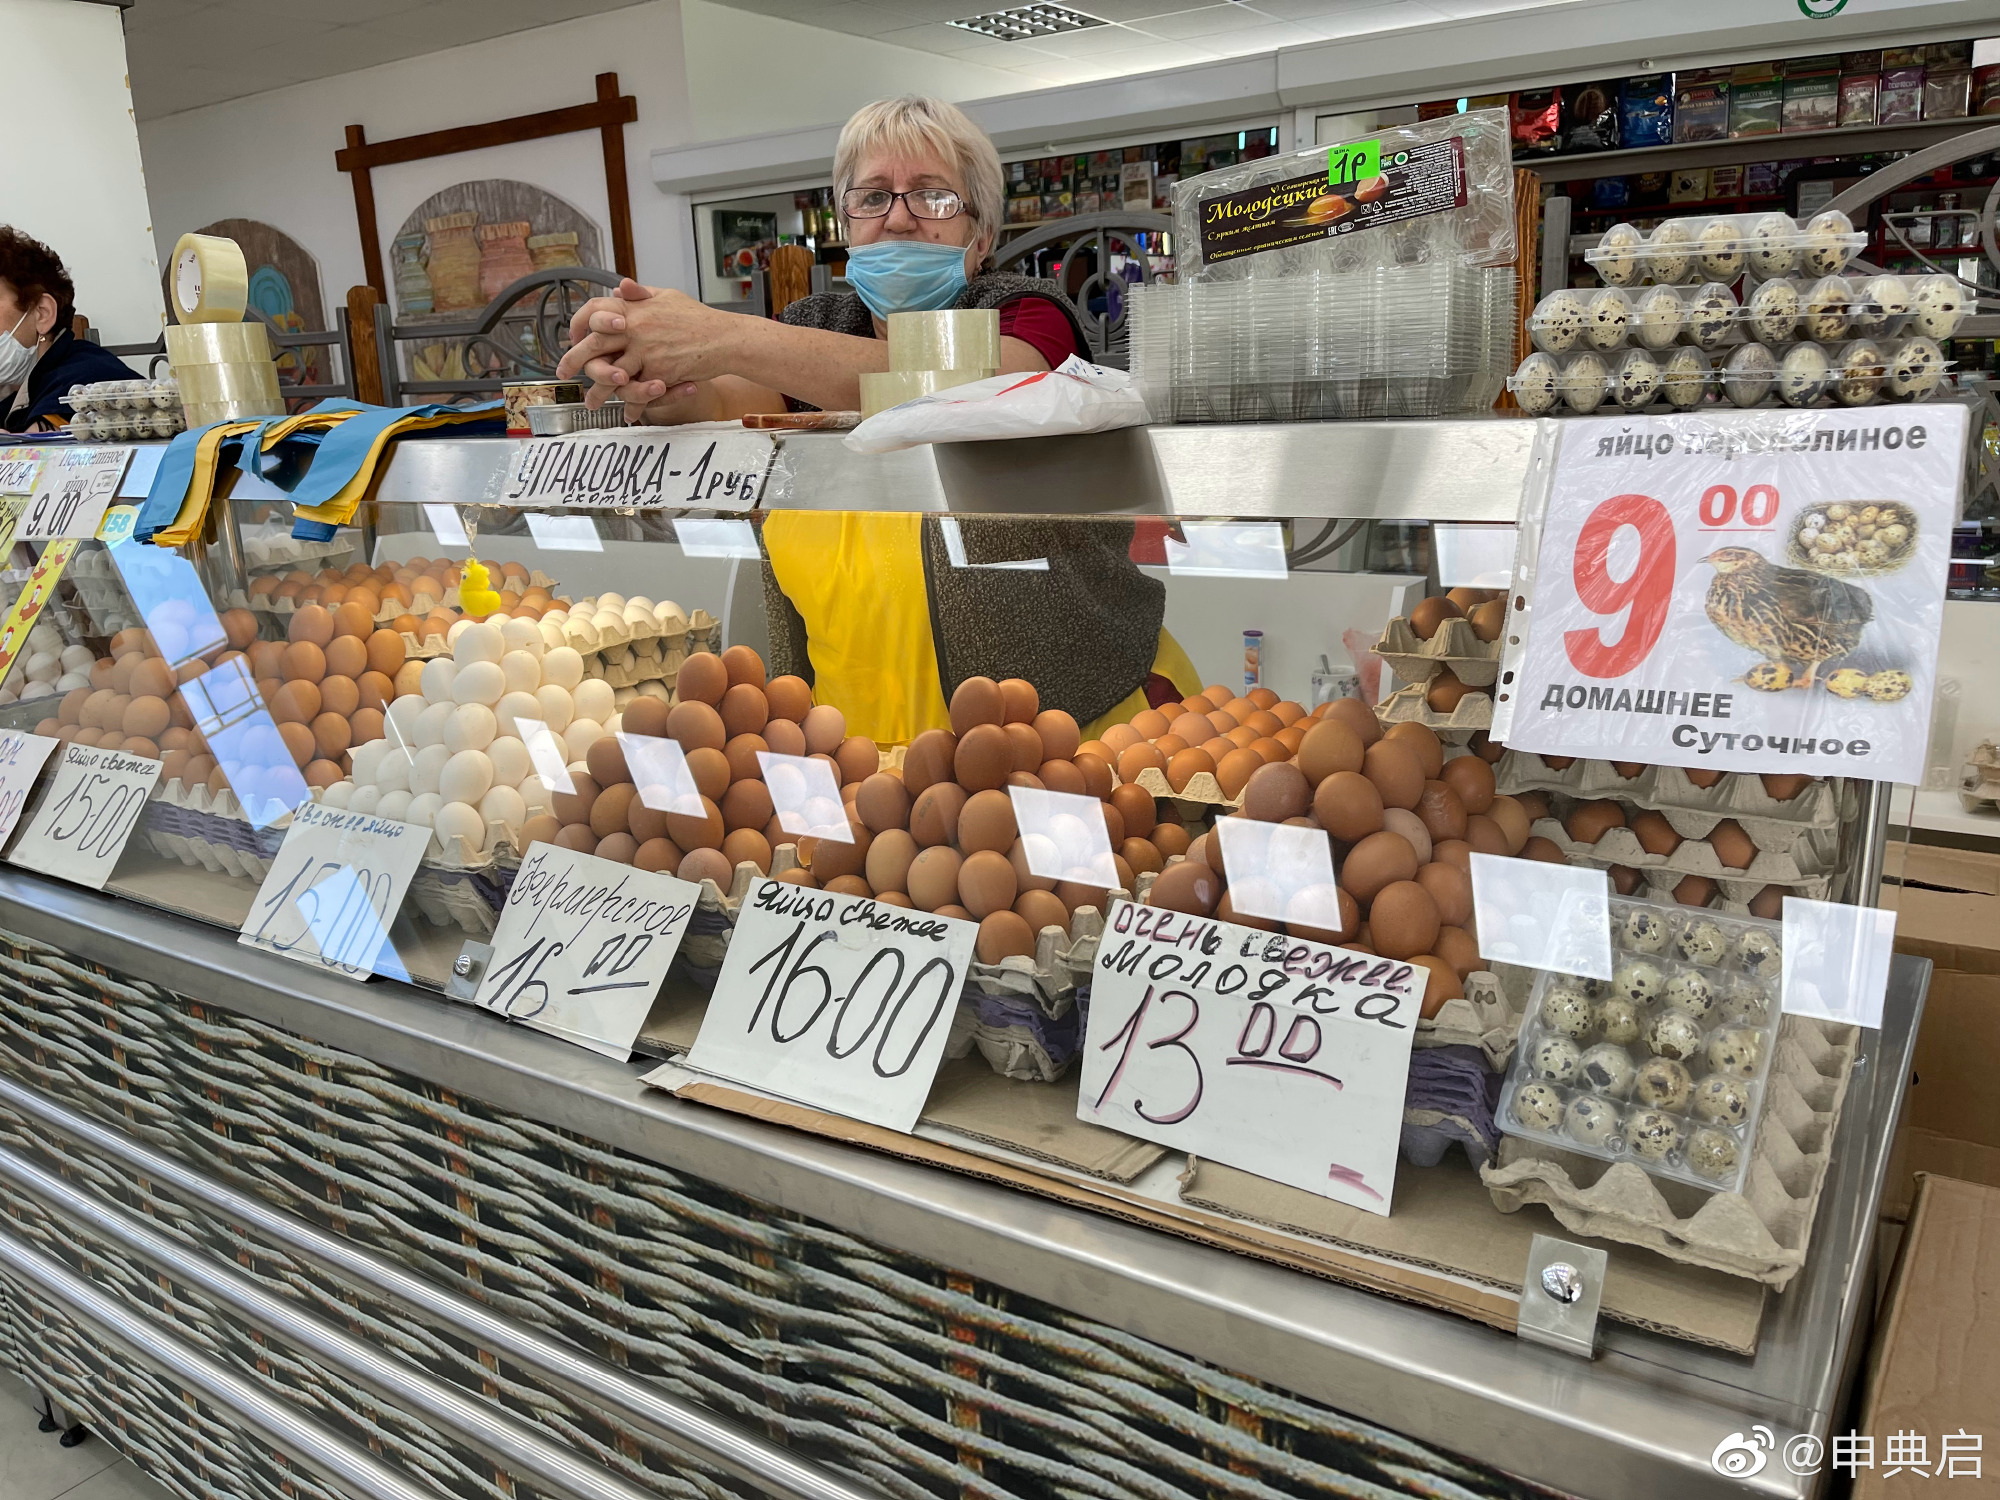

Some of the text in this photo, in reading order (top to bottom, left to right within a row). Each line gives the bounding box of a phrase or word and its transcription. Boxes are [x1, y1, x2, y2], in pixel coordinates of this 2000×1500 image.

[1206, 184, 1329, 224] Молодецкие
[1595, 428, 1674, 461] яйцо
[562, 489, 665, 506] скотчем
[1563, 493, 1677, 679] 9
[1540, 684, 1734, 720] ДОМАШНЕЕ
[1671, 724, 1872, 757] Суточное
[1094, 984, 1204, 1125] 13
